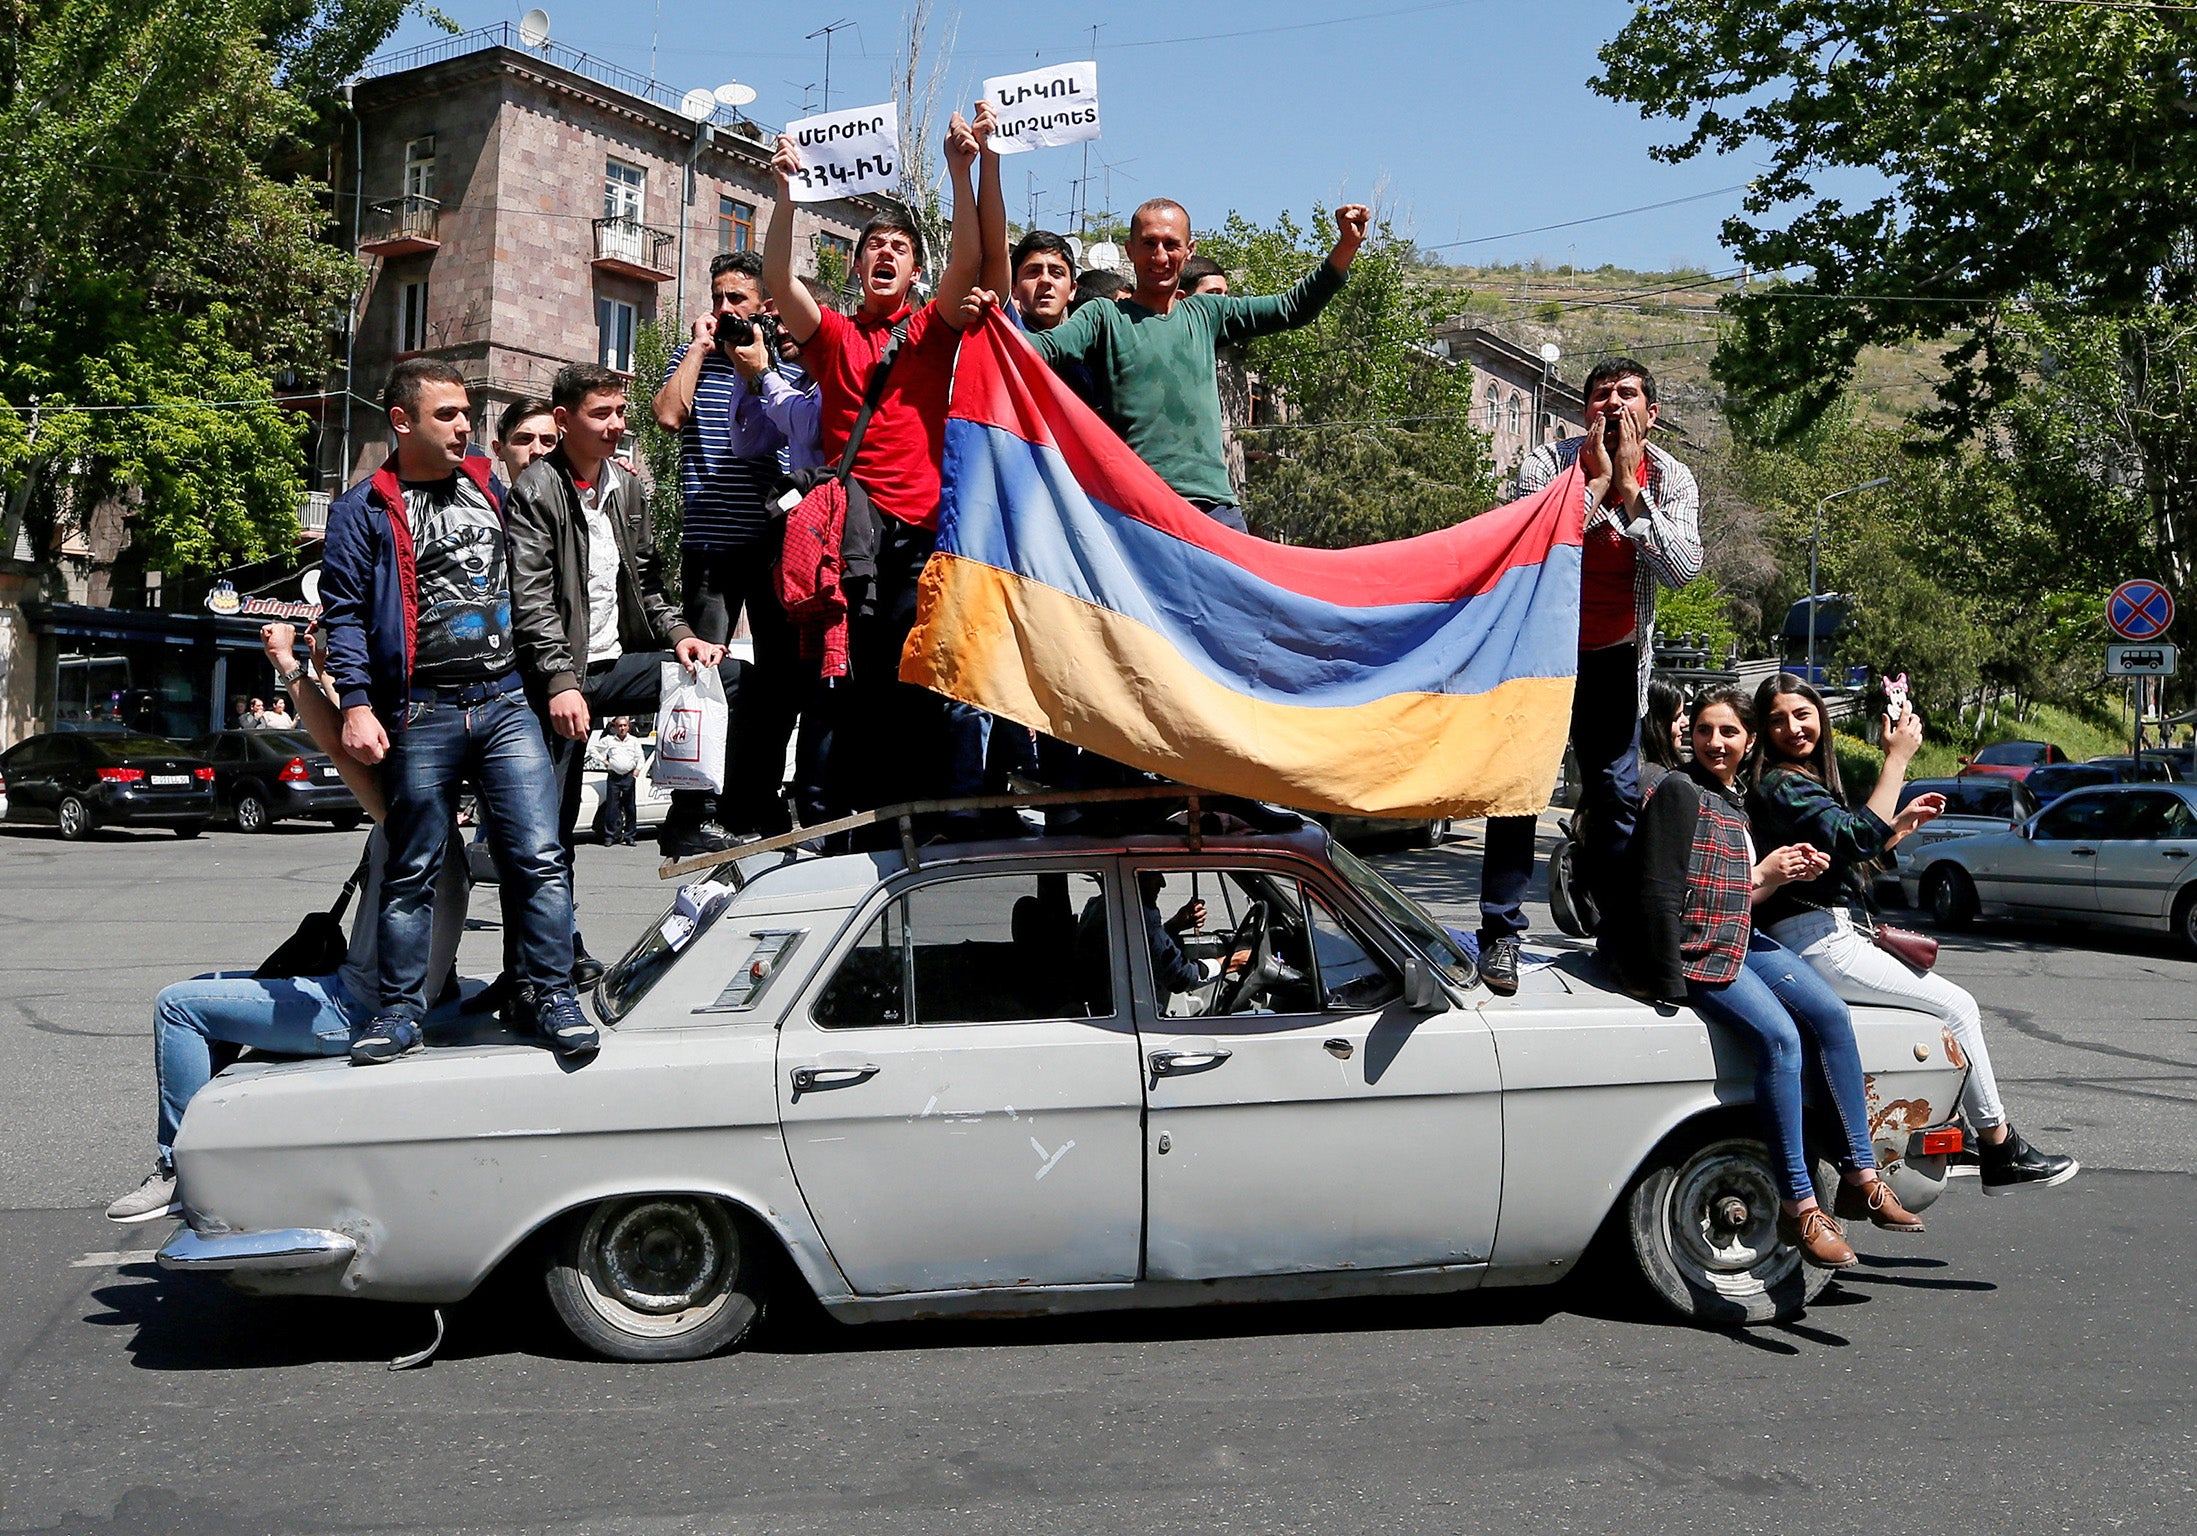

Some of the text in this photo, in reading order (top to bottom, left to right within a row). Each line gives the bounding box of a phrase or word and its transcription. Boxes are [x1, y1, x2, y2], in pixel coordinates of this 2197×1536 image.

[997, 77, 1081, 107] ՆԻԿՈԼ
[798, 117, 884, 147] ՄԵՐԺԻՐ
[797, 154, 893, 188] ՀՀԿ-ԻՆ
